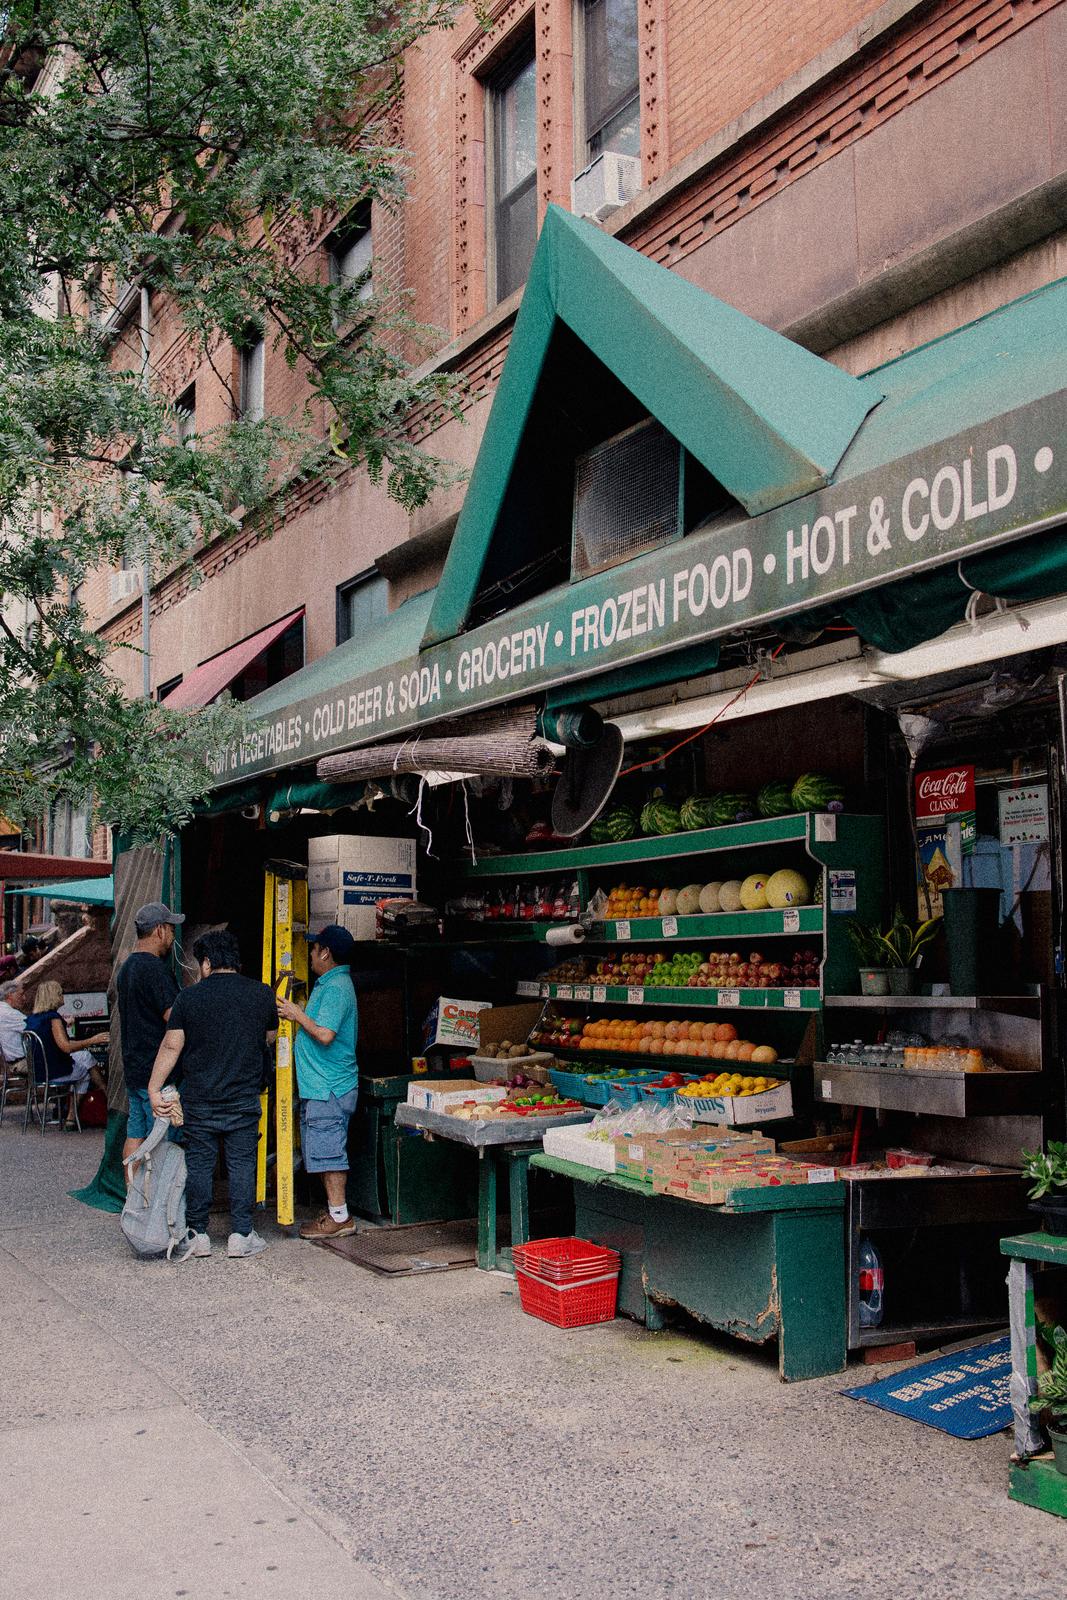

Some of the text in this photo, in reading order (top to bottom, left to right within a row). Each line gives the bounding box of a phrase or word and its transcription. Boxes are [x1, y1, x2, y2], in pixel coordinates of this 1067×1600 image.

[240, 714, 302, 765] VEGETABLES
[312, 699, 347, 742] COLD
[348, 686, 383, 728] BEER
[385, 681, 395, 716] &
[399, 662, 440, 713] SODA
[457, 621, 551, 693] GROCERY
[571, 578, 665, 656] FROZEN
[673, 547, 753, 621] FOOD
[786, 504, 857, 584] HOT
[866, 496, 892, 556] &
[902, 444, 1018, 541] COLD
[919, 770, 968, 799] Coca-Cola
[929, 799, 959, 813] CLASSIC
[887, 1370, 966, 1402] BUD
